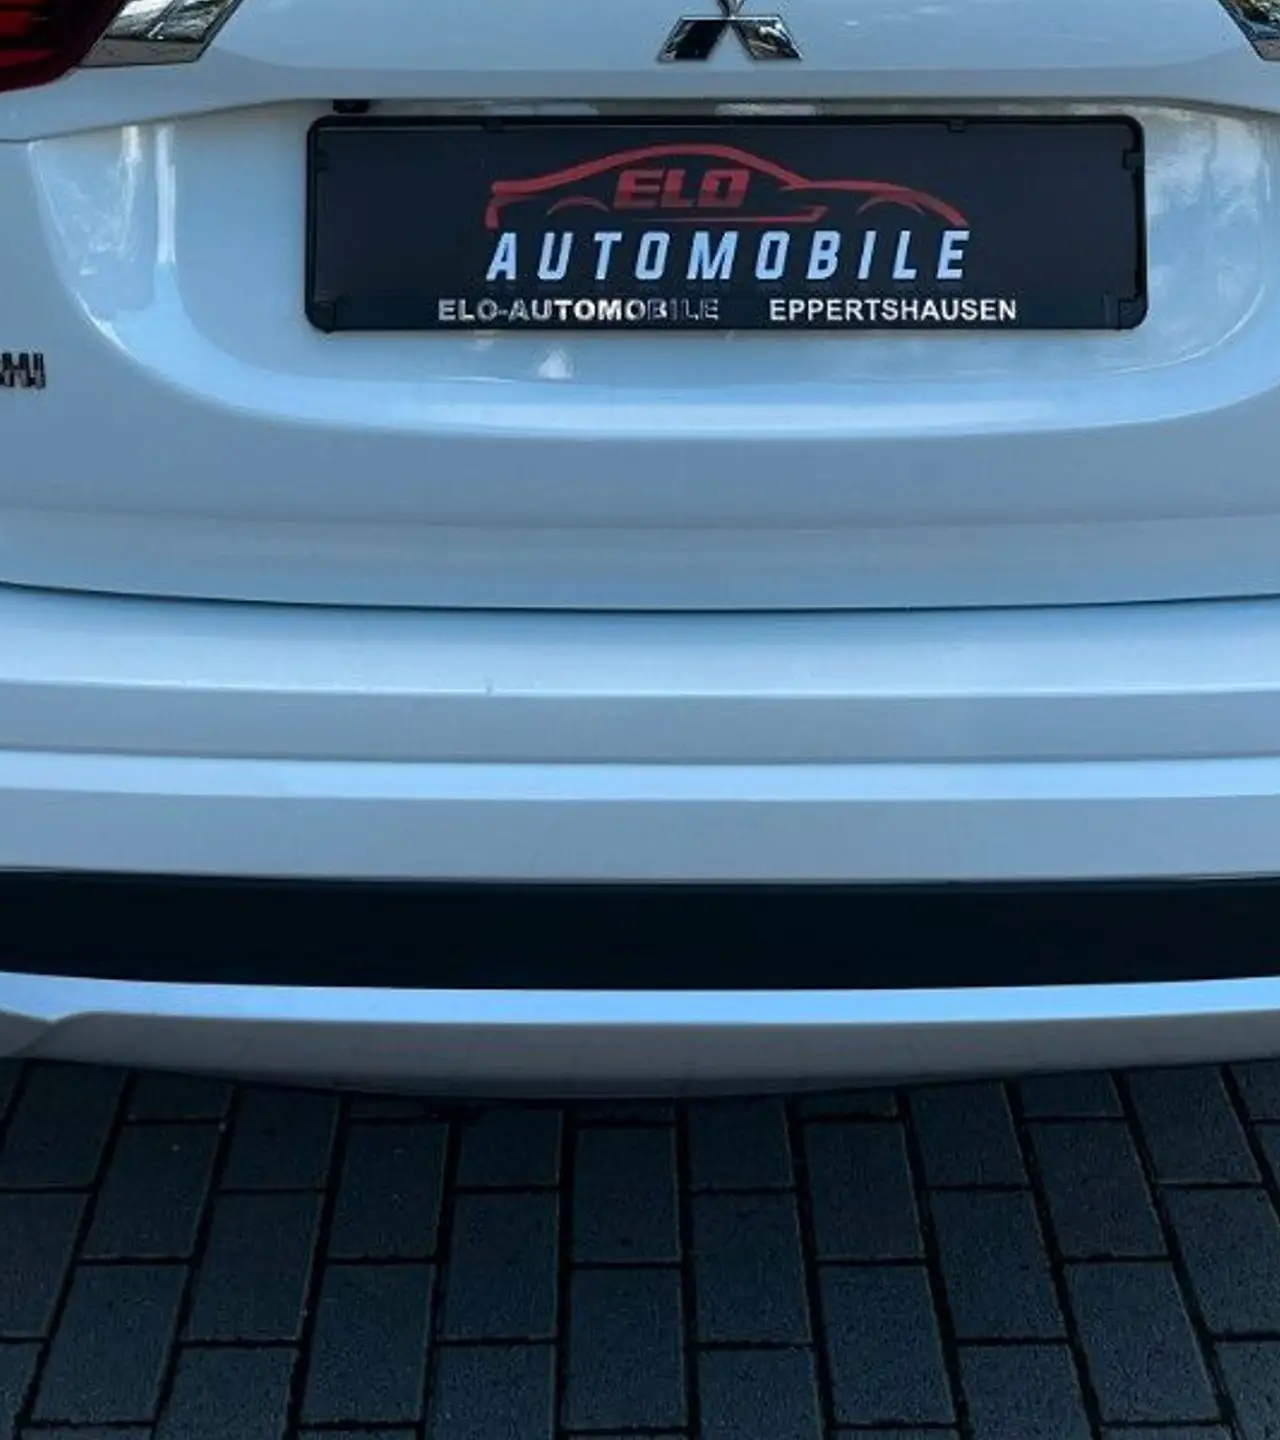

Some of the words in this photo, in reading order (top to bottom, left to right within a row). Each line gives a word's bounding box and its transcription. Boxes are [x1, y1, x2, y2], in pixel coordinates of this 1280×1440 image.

[613, 168, 750, 209] ELO
[485, 230, 970, 281] AUTOMOBILE
[437, 298, 719, 322] ELO-AUTOMOBILE
[770, 298, 1017, 321] EPPERTSHAUSEN
